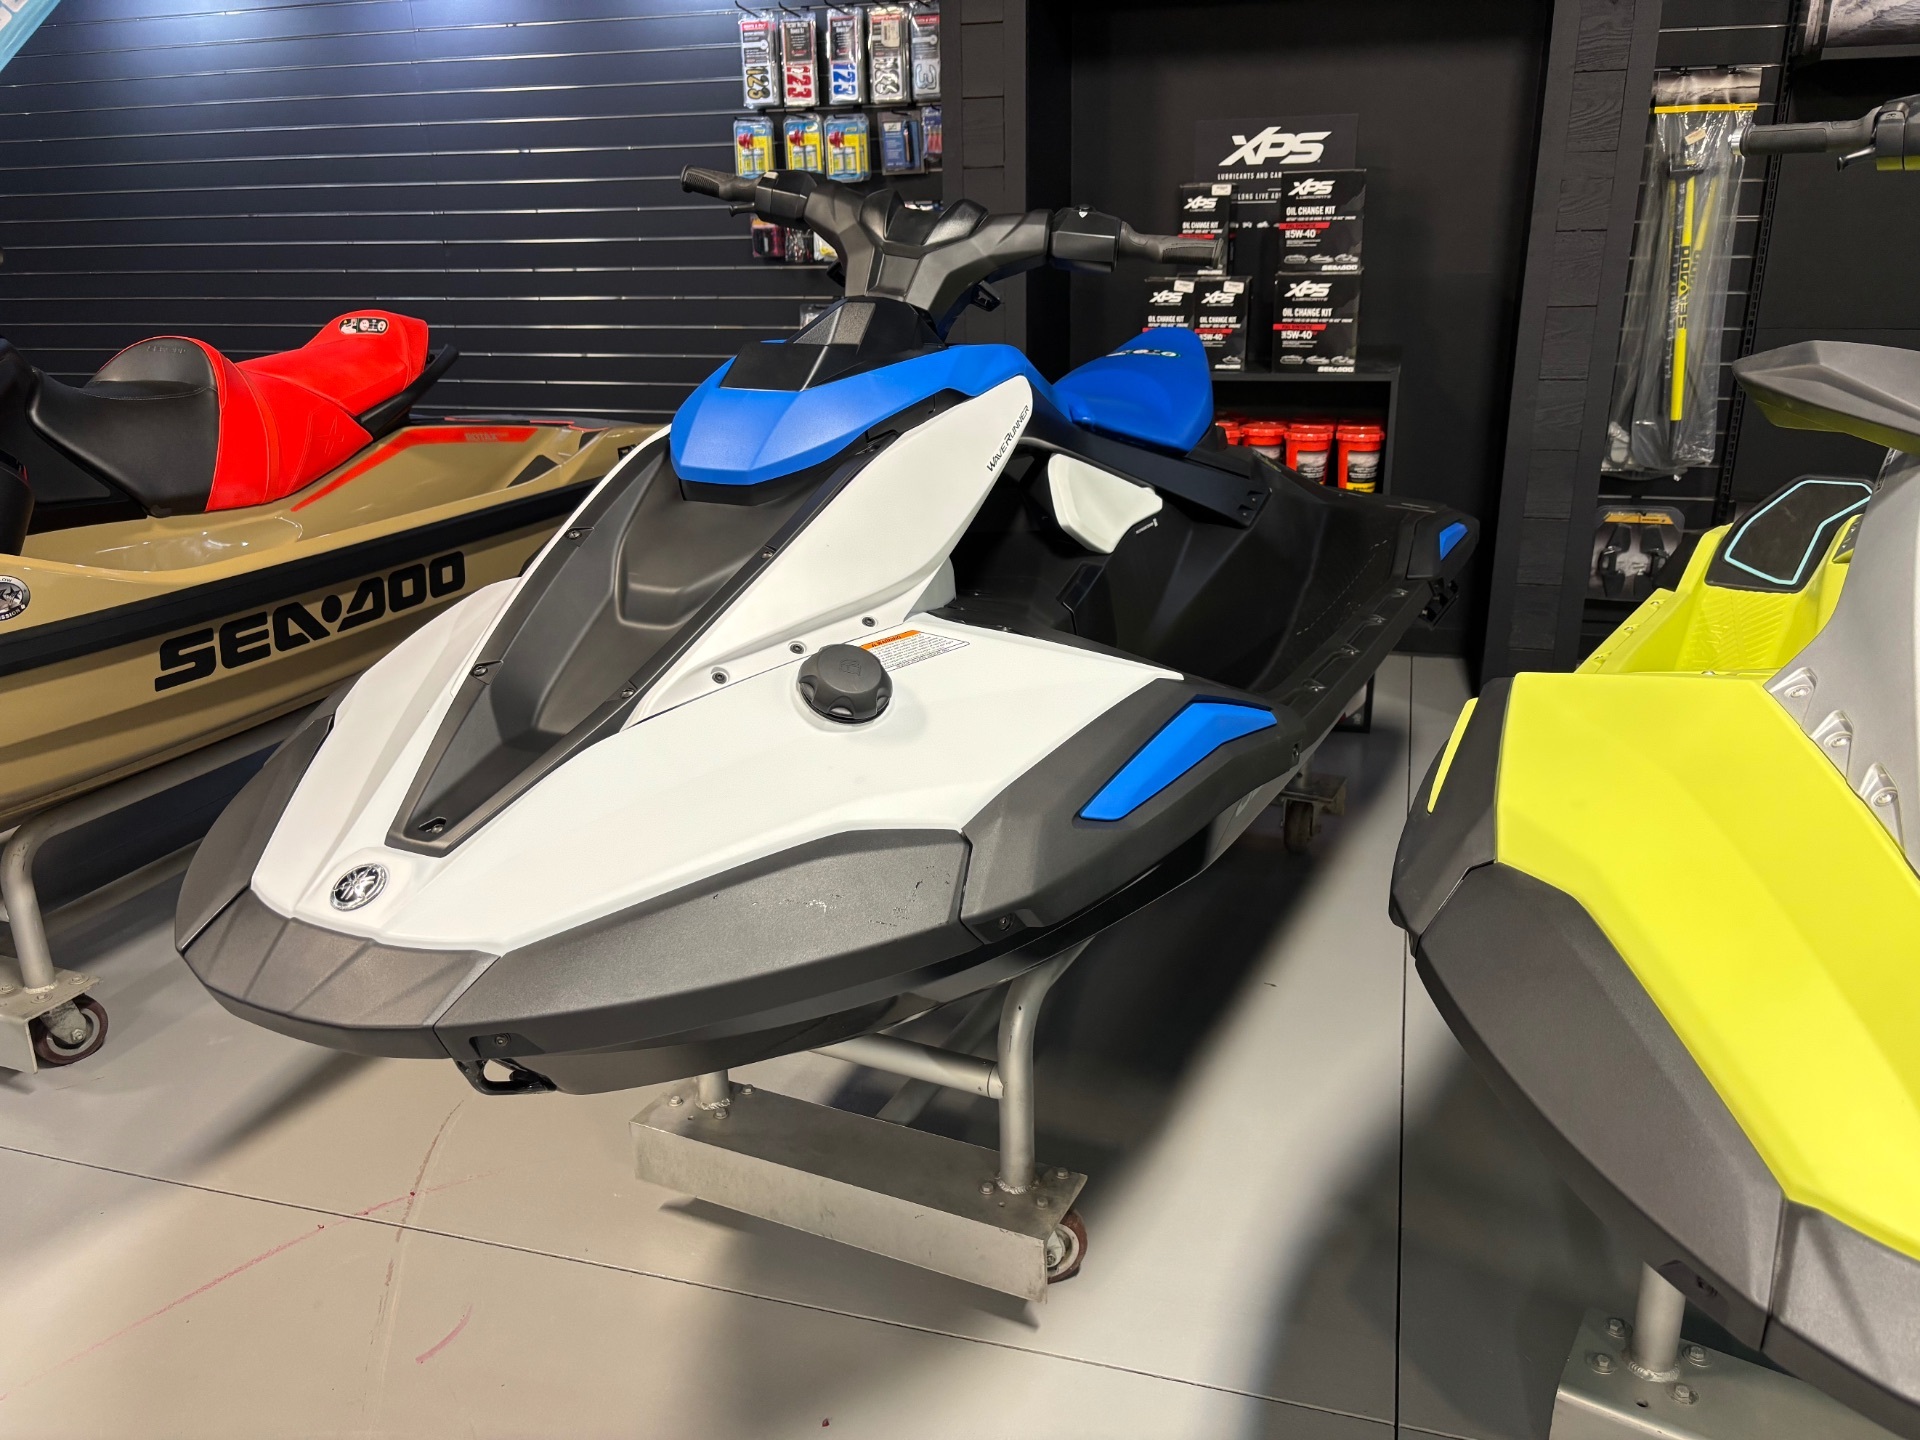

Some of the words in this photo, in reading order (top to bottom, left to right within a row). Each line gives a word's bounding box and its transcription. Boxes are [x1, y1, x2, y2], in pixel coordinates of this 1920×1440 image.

[1218, 126, 1332, 166] XPS
[1288, 178, 1335, 196] XPS
[1184, 195, 1218, 209] XPS
[1286, 206, 1297, 216] OIL
[1298, 206, 1324, 216] CHANGE
[1325, 205, 1336, 215] KIT
[1284, 280, 1332, 298] XPS
[1149, 290, 1184, 303] XPS
[1201, 290, 1237, 304] XPS
[1282, 308, 1293, 317] OIL
[1294, 308, 1320, 317] CHANGE
[1321, 308, 1333, 317] KIT
